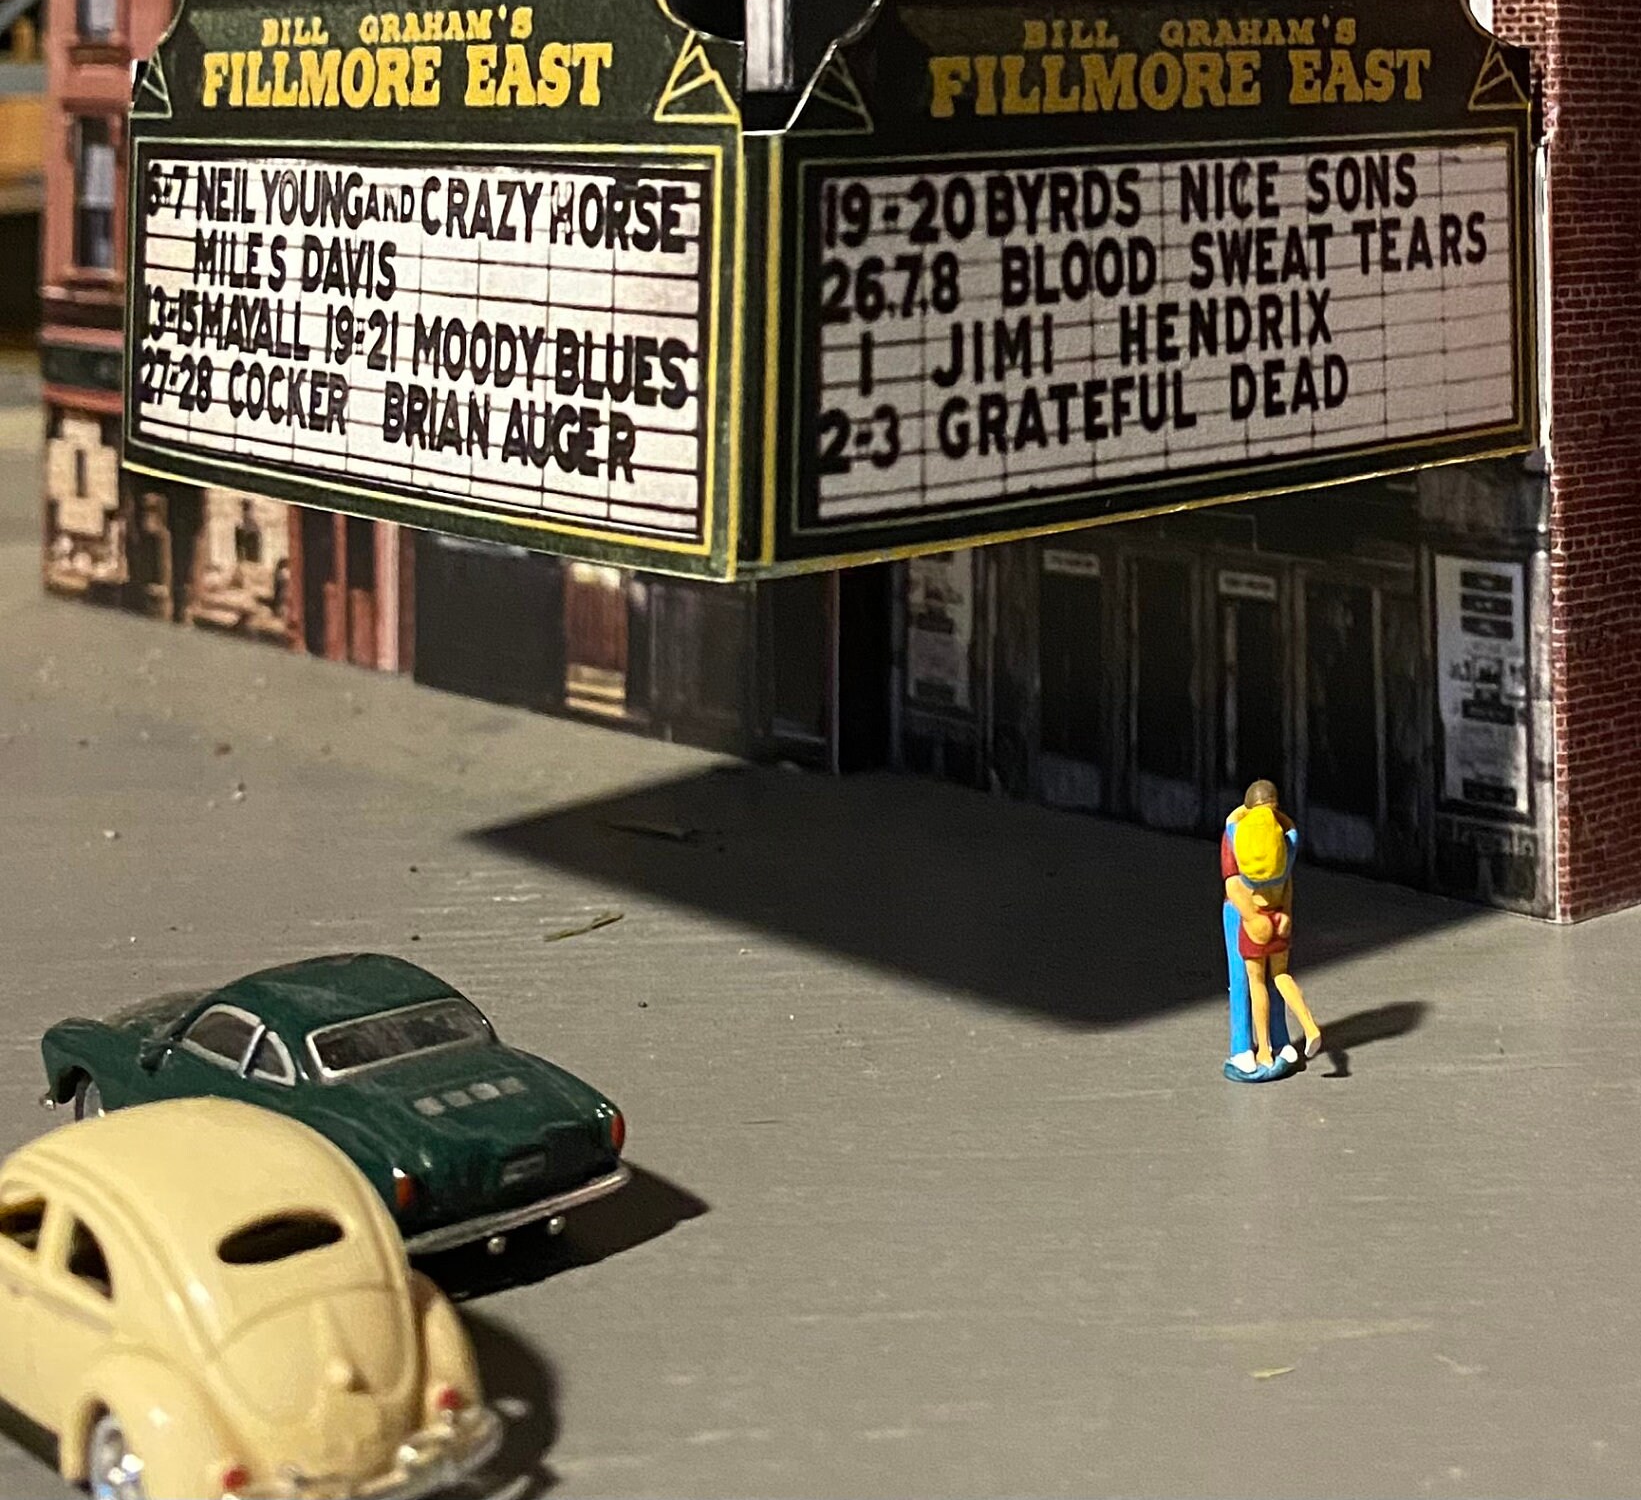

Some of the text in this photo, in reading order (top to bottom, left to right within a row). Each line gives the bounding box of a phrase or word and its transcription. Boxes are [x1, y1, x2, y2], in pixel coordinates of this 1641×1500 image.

[262, 5, 533, 47] BILL GRAHAM'S
[1023, 13, 1357, 50] BILL GRAHAM'S
[203, 43, 612, 108] FILLMORE EAST
[931, 49, 1432, 118] FILLMORE EAST
[197, 166, 256, 224] NEIL
[261, 170, 363, 230] YOUNG
[363, 183, 415, 223] AND
[421, 176, 544, 244] CRAZY
[549, 181, 686, 253] HORSE
[825, 152, 1418, 248] 19-20 BYRDS NICE SONS
[193, 228, 397, 302] MILES DAVIS
[1002, 237, 1156, 308] BLOOD
[1189, 223, 1333, 290] SWEAT
[1352, 210, 1487, 276] TEARS
[200, 291, 310, 362] MAYALL
[326, 303, 399, 374] 19-21
[413, 313, 544, 392] MOODY
[555, 329, 690, 410] BLUES
[931, 313, 1054, 388] JIMI
[1118, 287, 1332, 366] HENDRIX
[138, 345, 636, 484] 27-28 COCKER BRIAN AUGER
[816, 353, 1349, 474] 2-3 GRATEFUL DEAD
